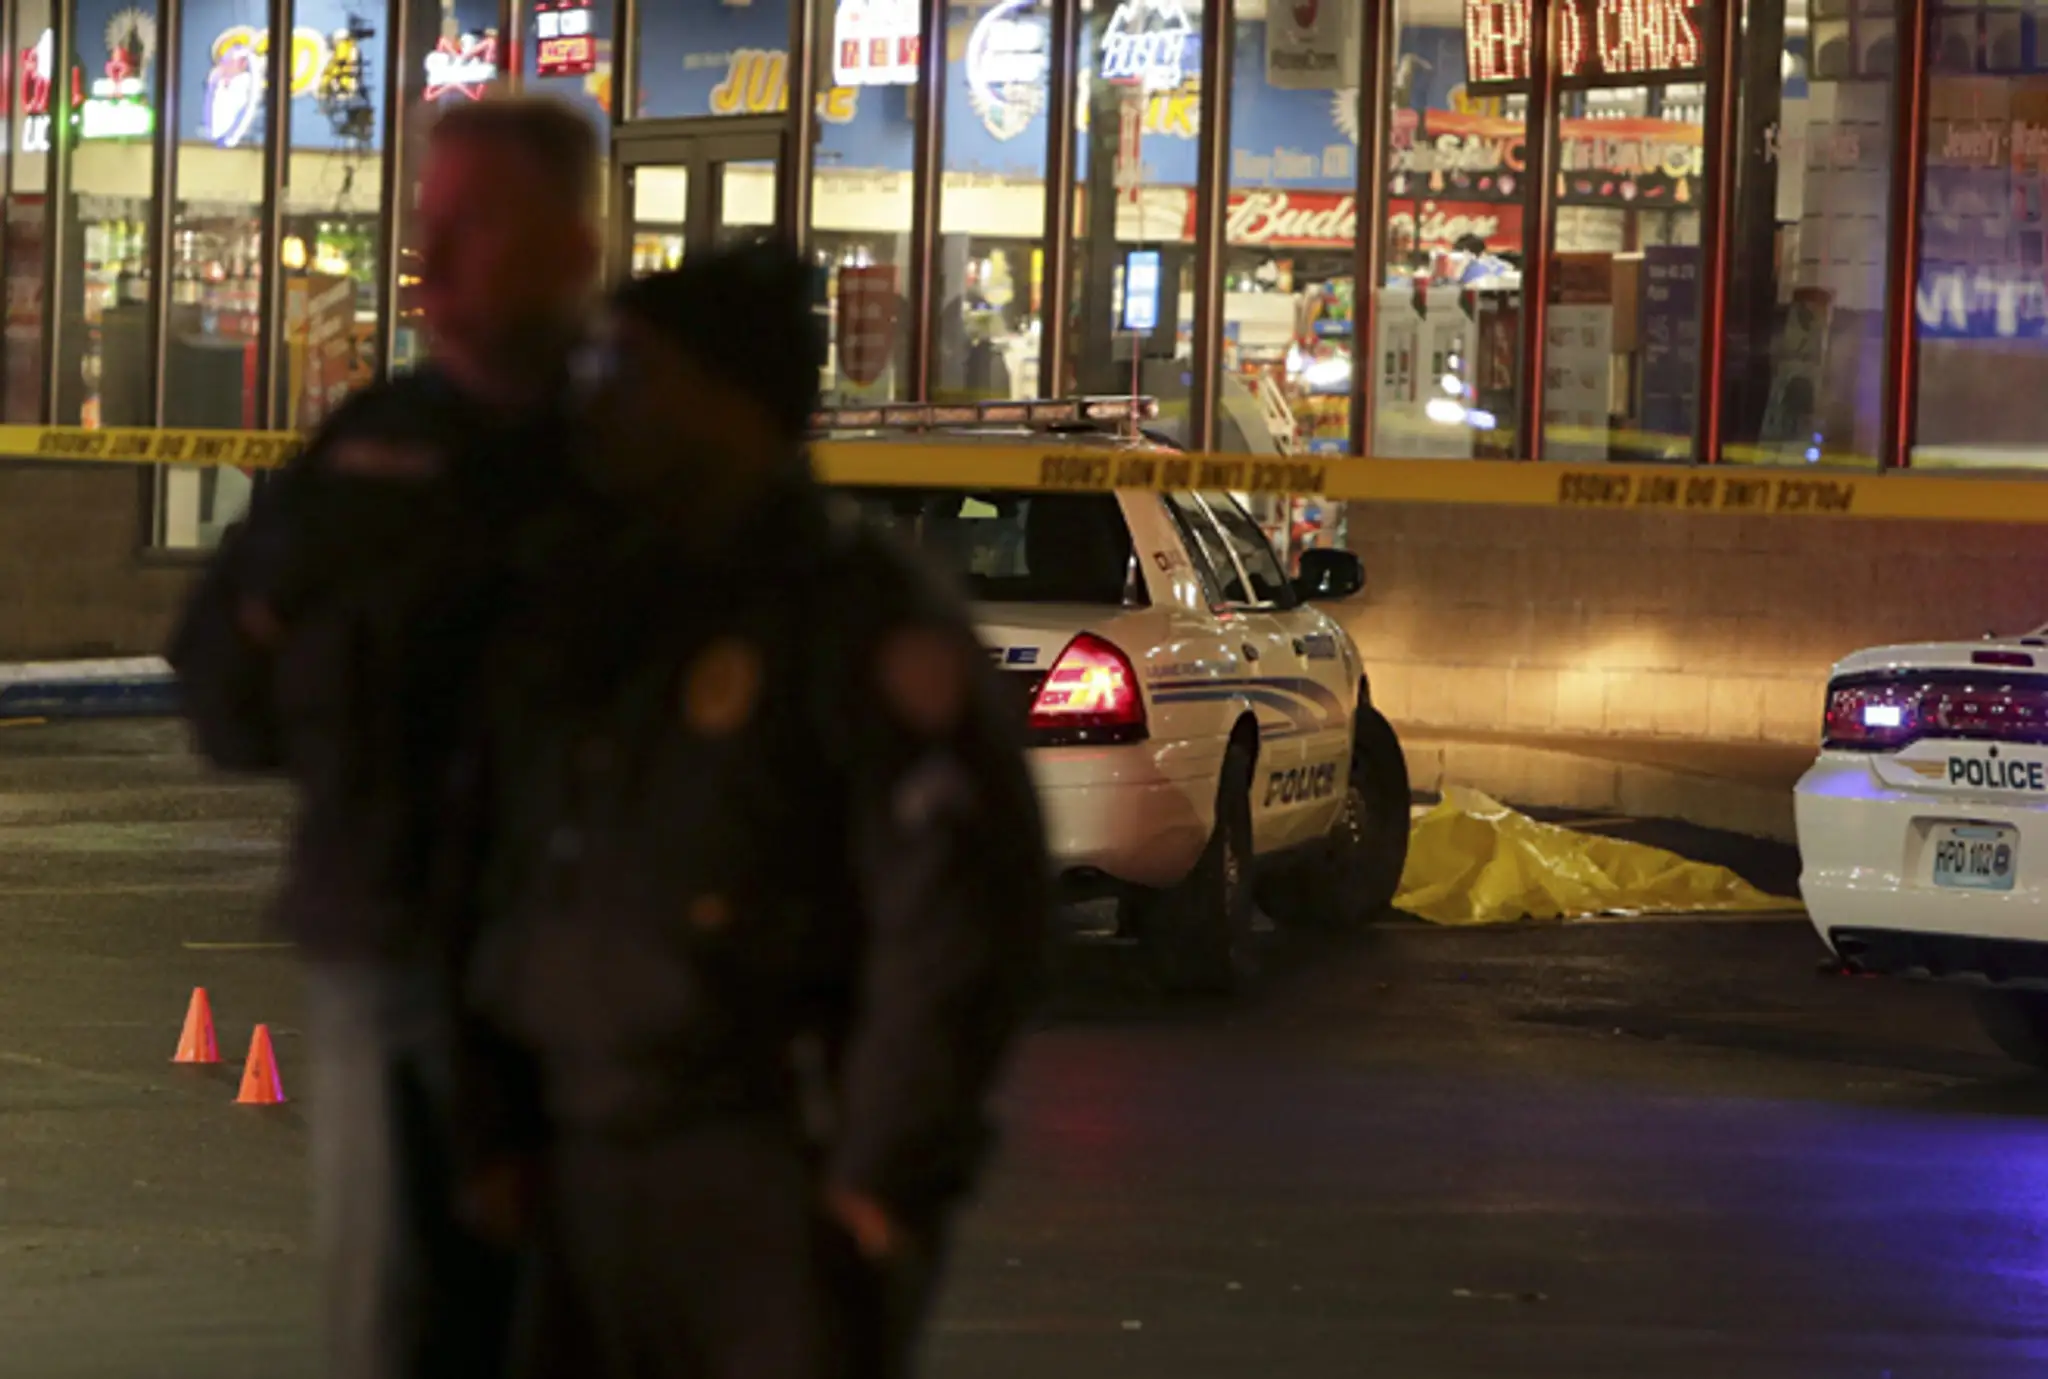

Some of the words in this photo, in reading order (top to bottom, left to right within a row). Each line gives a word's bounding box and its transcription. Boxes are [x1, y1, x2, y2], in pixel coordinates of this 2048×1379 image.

[1597, 0, 1696, 73] CARDS
[1040, 455, 1111, 487] CROSS
[1114, 458, 1156, 489] NOT
[1161, 459, 1192, 490] DO
[1198, 460, 1245, 491] LINE
[1251, 461, 1326, 492] POLICE
[1558, 473, 1631, 505] CROSS
[1635, 475, 1679, 506] NOT
[1685, 476, 1717, 507] DO
[1722, 478, 1771, 509] LINE
[1775, 478, 1855, 511] POLICE
[1264, 762, 1336, 808] POLICE
[1949, 757, 2044, 790] POLICE
[1936, 840, 1965, 873] HPD
